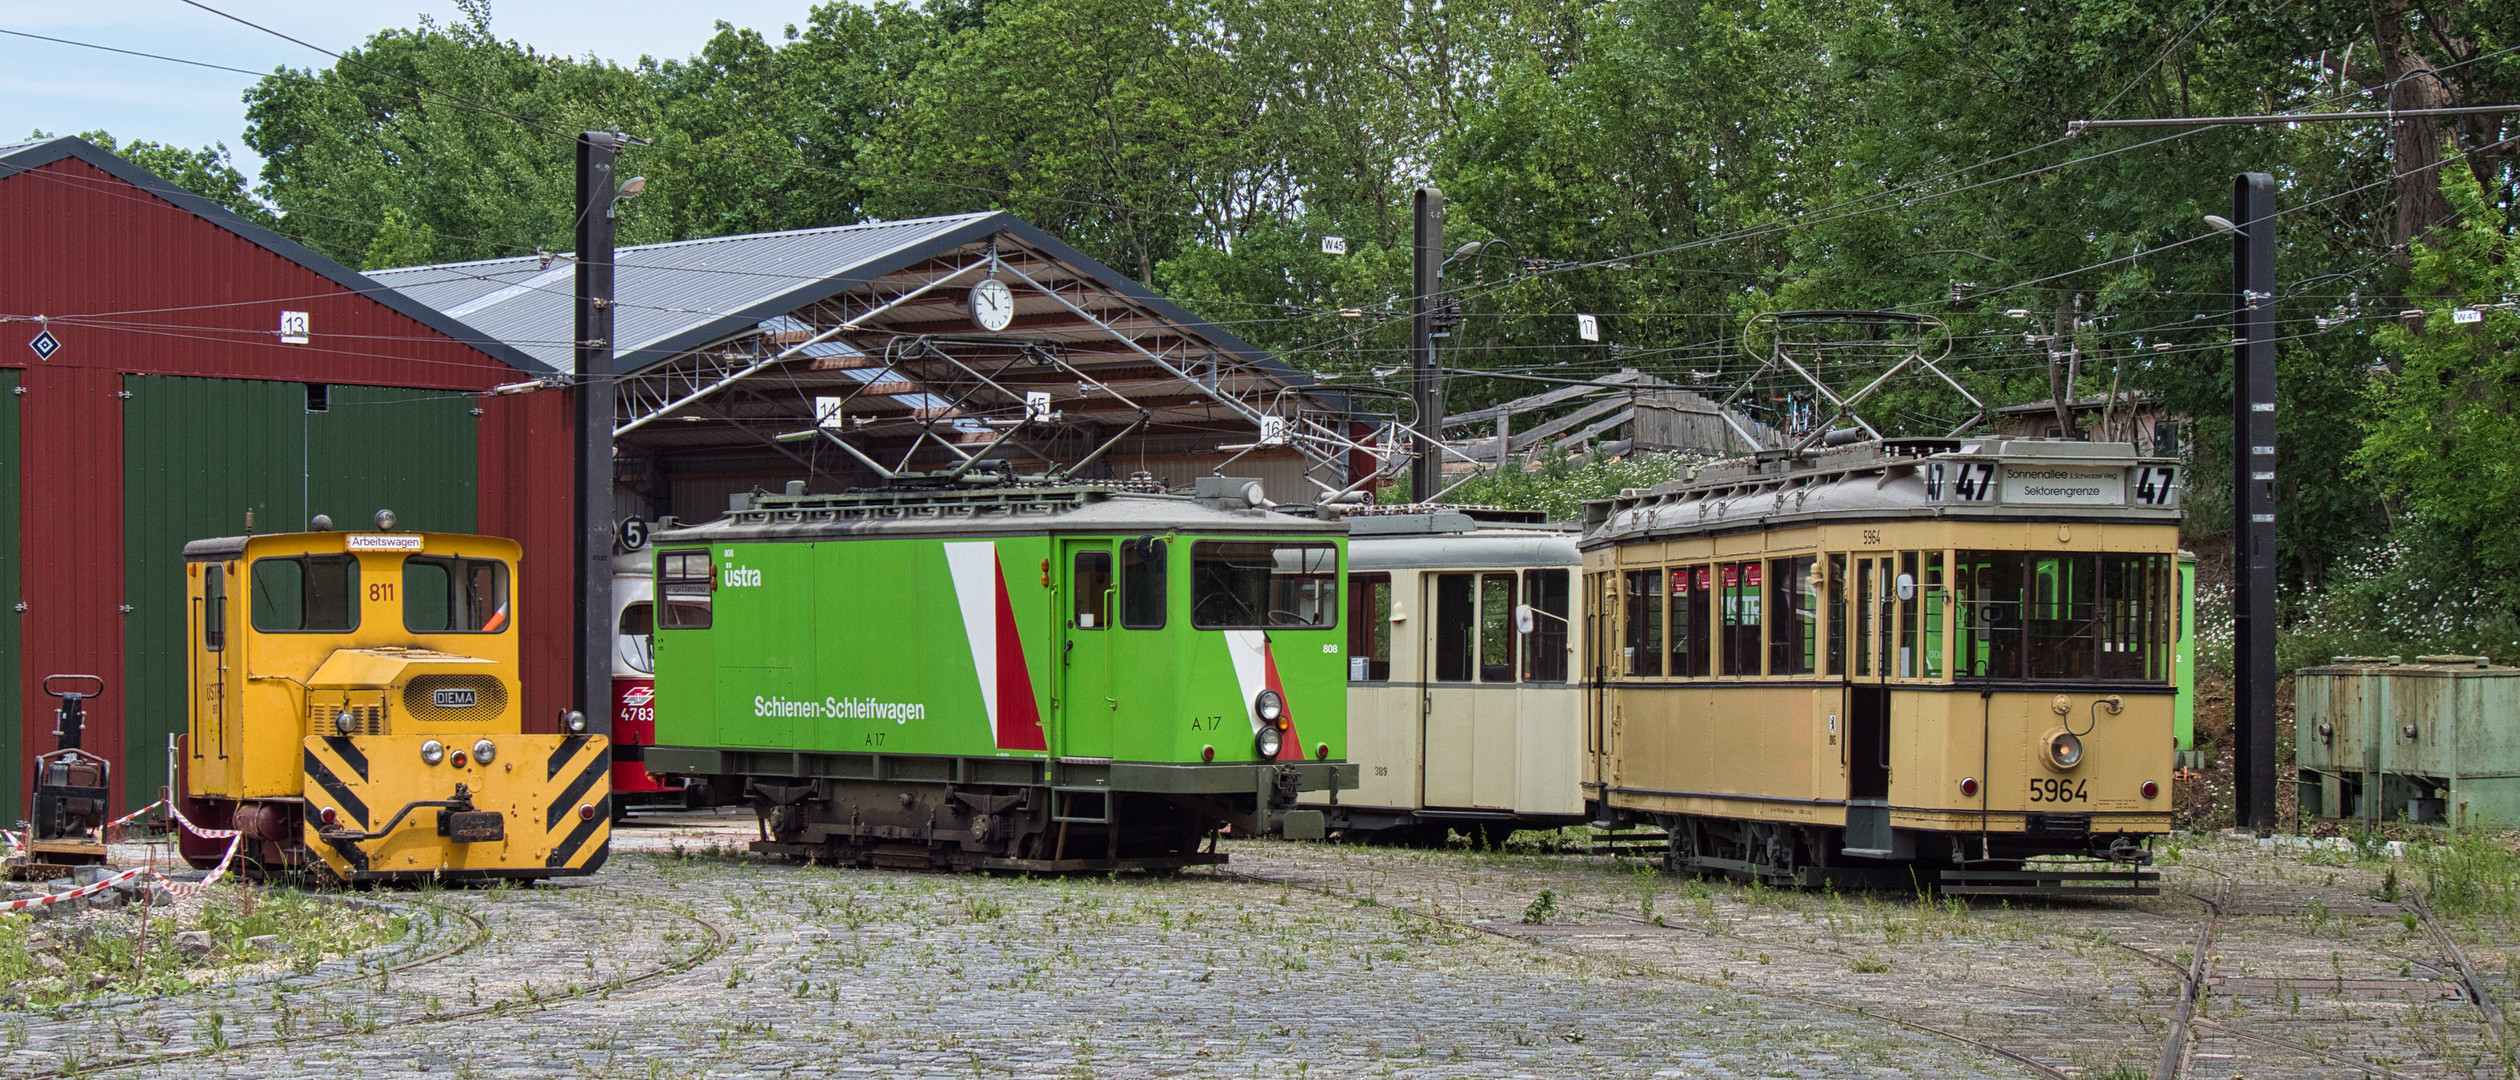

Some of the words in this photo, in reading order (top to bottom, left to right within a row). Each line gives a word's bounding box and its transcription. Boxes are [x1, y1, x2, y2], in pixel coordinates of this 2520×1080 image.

[286, 316, 305, 335] 13
[1581, 319, 1593, 335] 17
[820, 402, 837, 420] 14
[1031, 397, 1046, 415] 15
[1264, 420, 1280, 438] 16
[1928, 464, 1944, 501] 47
[1956, 463, 1995, 501] 47
[2007, 469, 2068, 479] Sonnenallee
[2024, 485, 2100, 497] Sektorengrenze
[2136, 467, 2175, 505] 47
[351, 536, 420, 548] Arbeitswagen
[627, 521, 641, 548] 5
[1863, 529, 1881, 545] 5964
[724, 562, 762, 588] üstra
[369, 583, 394, 602] 811
[1322, 644, 1338, 654] 808
[206, 682, 225, 701] ÜSTA
[437, 692, 474, 704] DIEMA
[621, 707, 654, 721] 4783
[754, 695, 925, 725] Schienen-Schleifwagen
[1191, 716, 1202, 731] A
[1207, 716, 1222, 731] 17
[865, 732, 872, 746] A
[875, 732, 886, 746] 17
[2029, 777, 2088, 803] 5964
